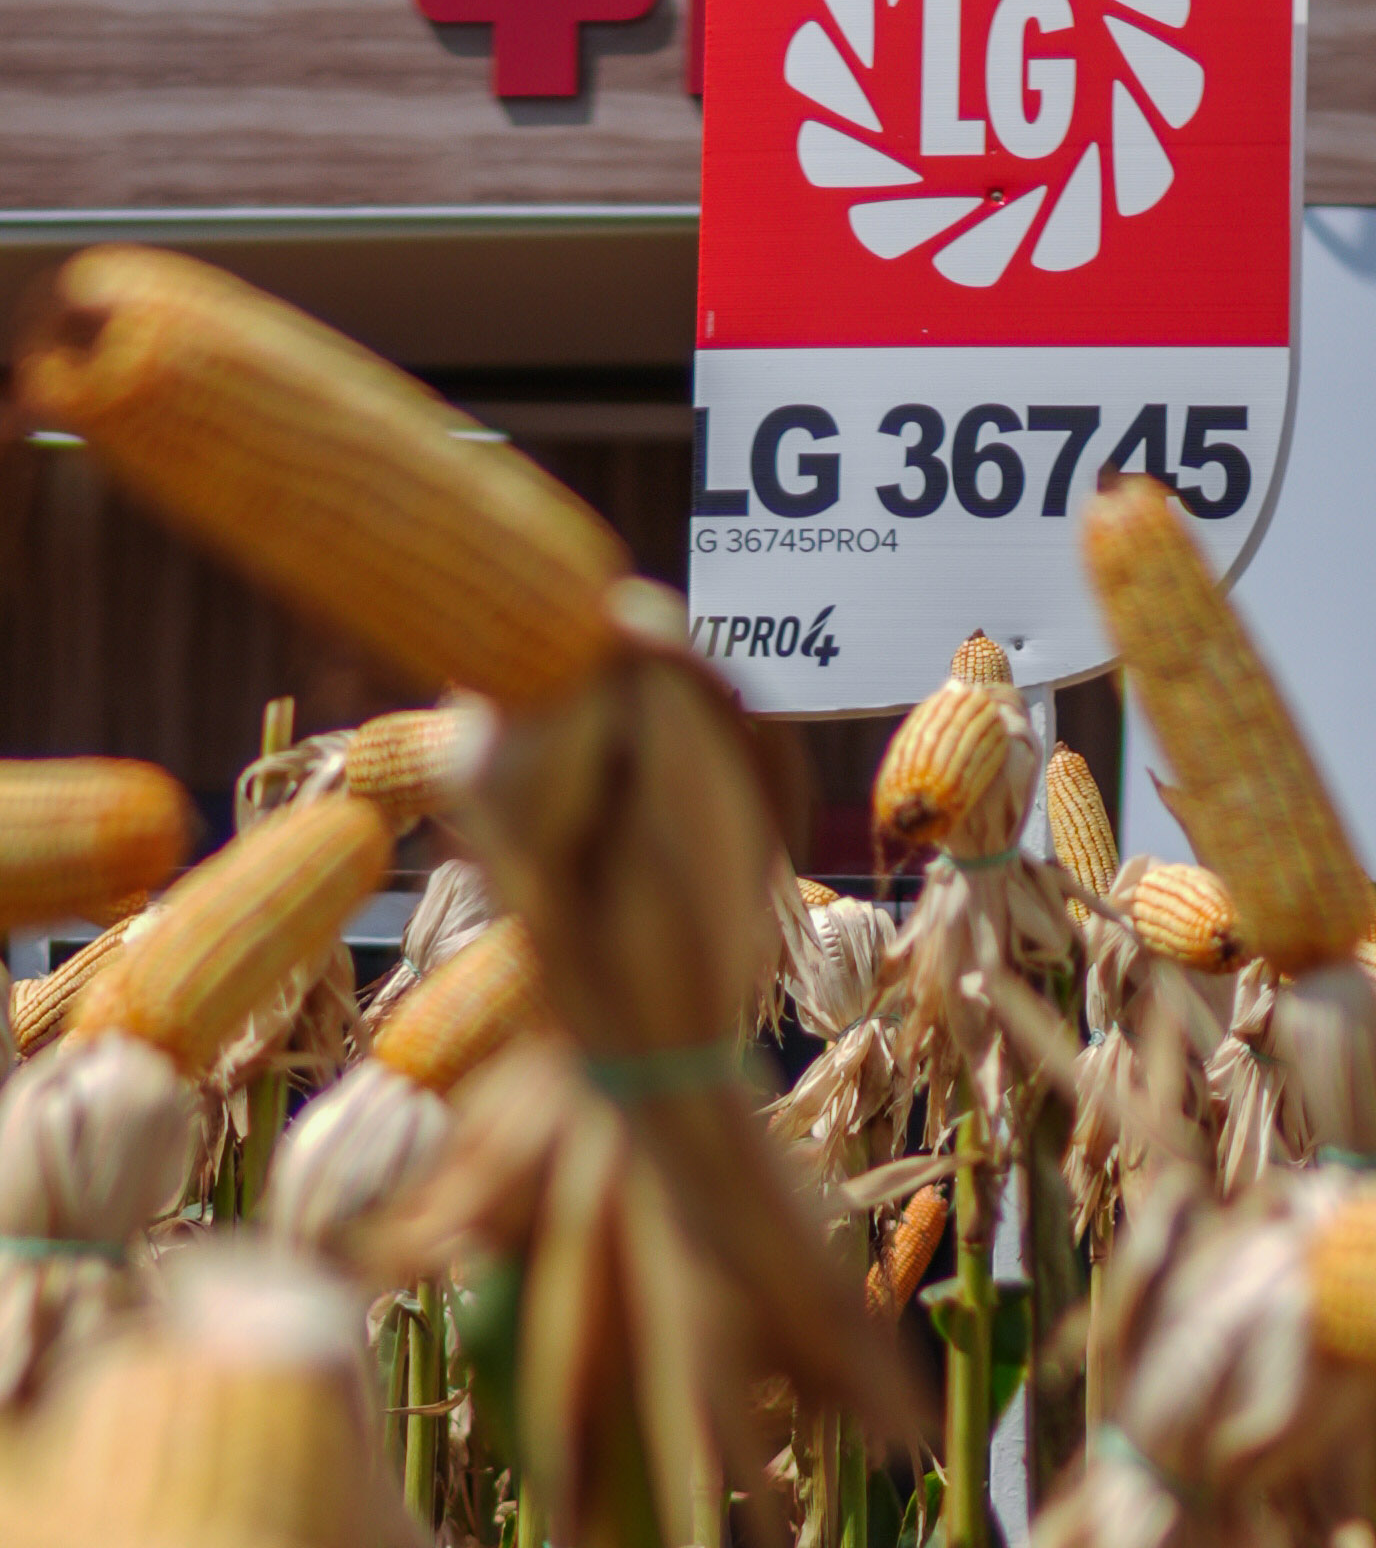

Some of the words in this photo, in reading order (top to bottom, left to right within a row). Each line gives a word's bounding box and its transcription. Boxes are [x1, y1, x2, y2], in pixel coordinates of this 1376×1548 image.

[691, 404, 841, 519] LG
[876, 403, 1252, 520] 36745
[690, 528, 718, 553] G
[725, 528, 899, 553] 36745PRO4
